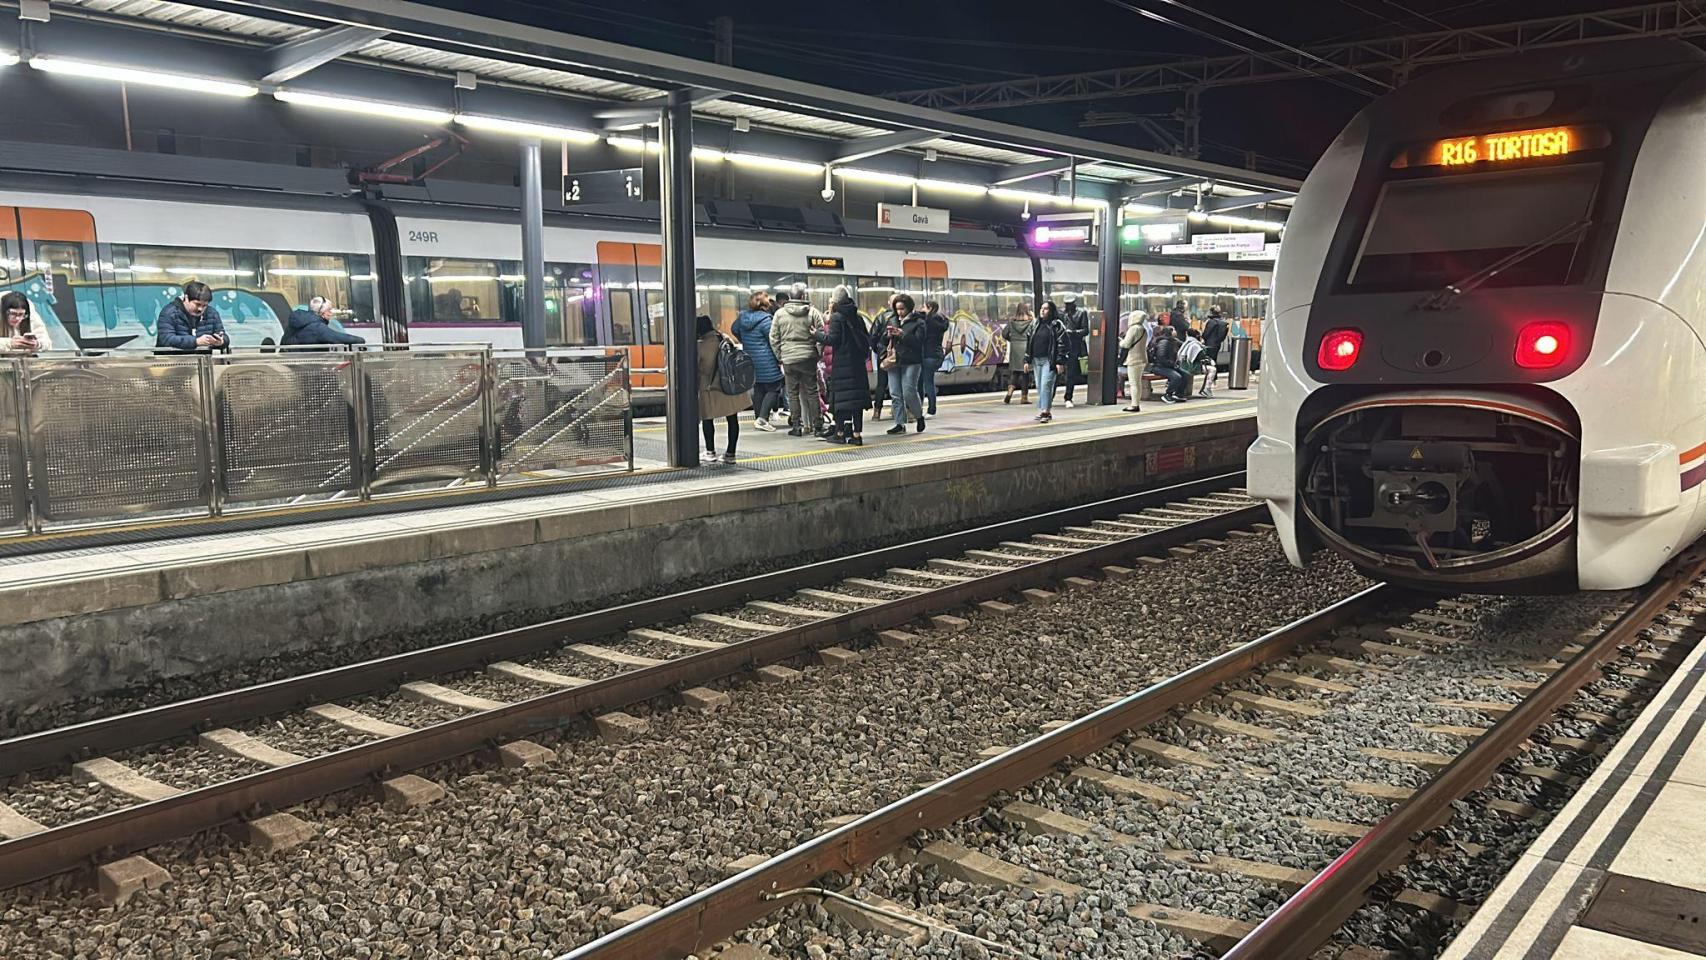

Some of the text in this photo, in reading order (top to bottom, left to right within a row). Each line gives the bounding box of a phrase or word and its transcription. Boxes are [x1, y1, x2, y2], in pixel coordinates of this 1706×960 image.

[1441, 131, 1569, 166] R16 TORTOSA
[572, 185, 580, 201] 2
[626, 181, 632, 197] 1
[409, 230, 439, 243] 249R
